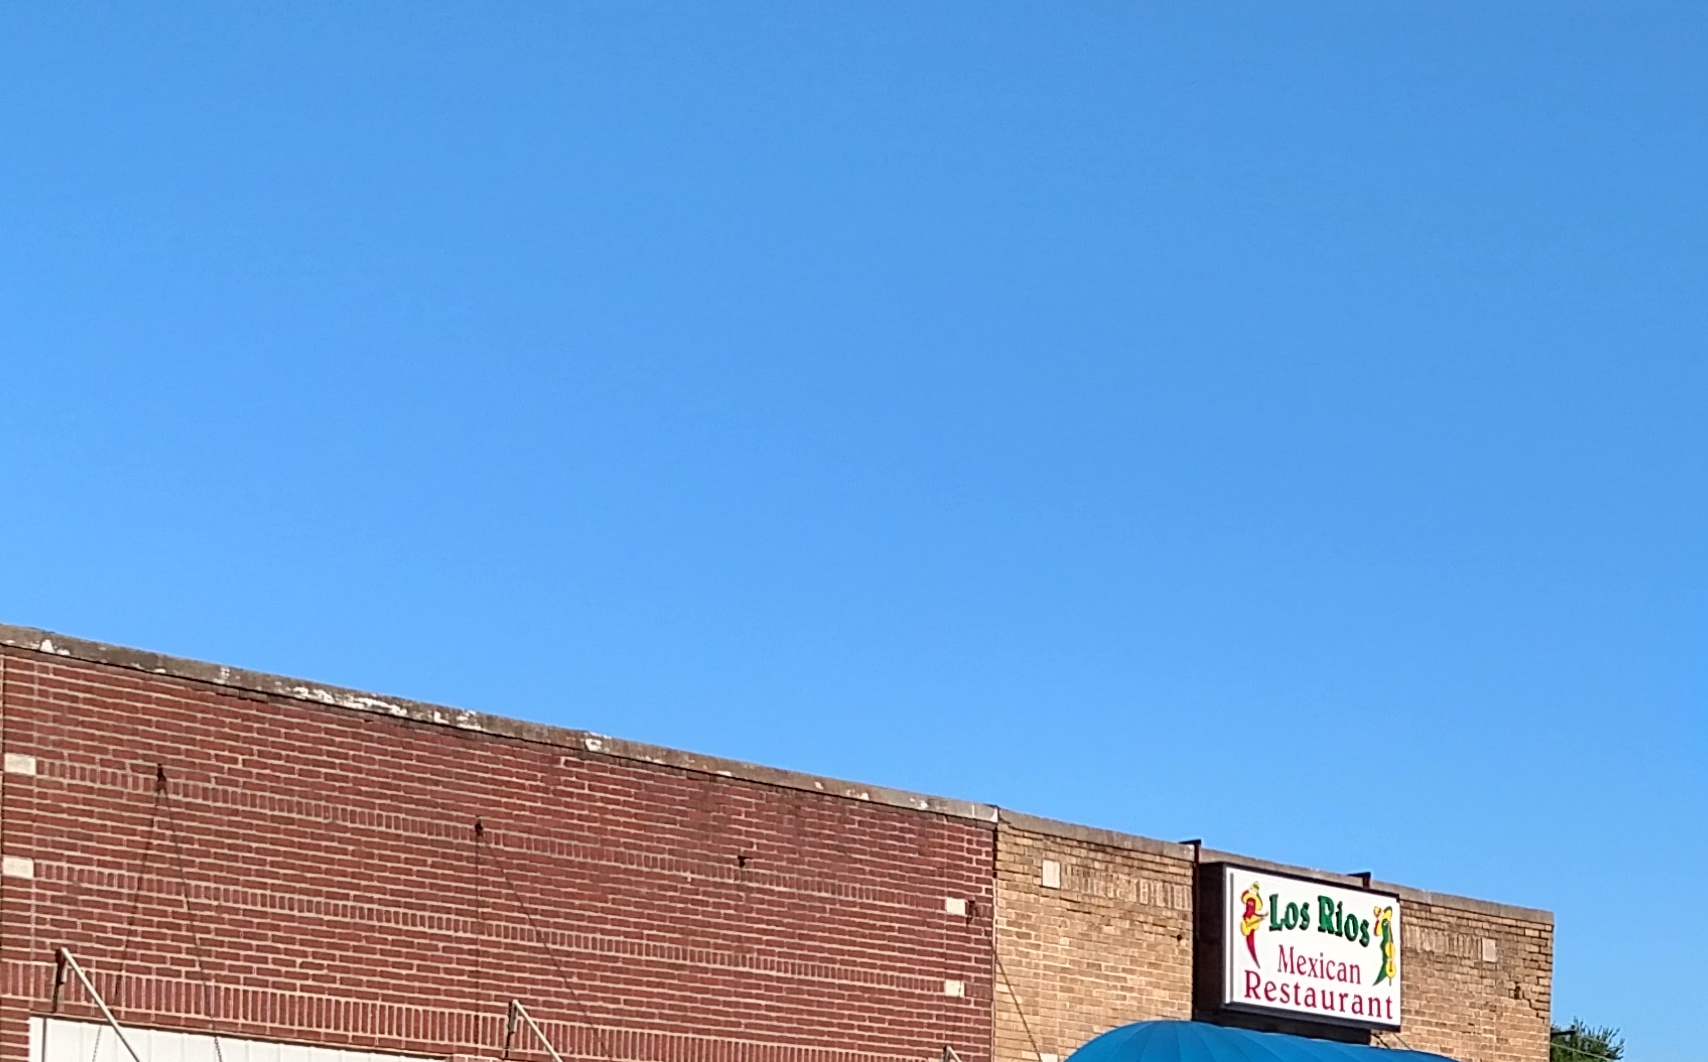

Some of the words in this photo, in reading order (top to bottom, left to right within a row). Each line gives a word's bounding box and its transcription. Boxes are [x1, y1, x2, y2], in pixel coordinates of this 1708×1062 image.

[1268, 893, 1311, 932] Los
[1277, 944, 1361, 985] Mexican
[1244, 969, 1393, 1020] Restaurant
